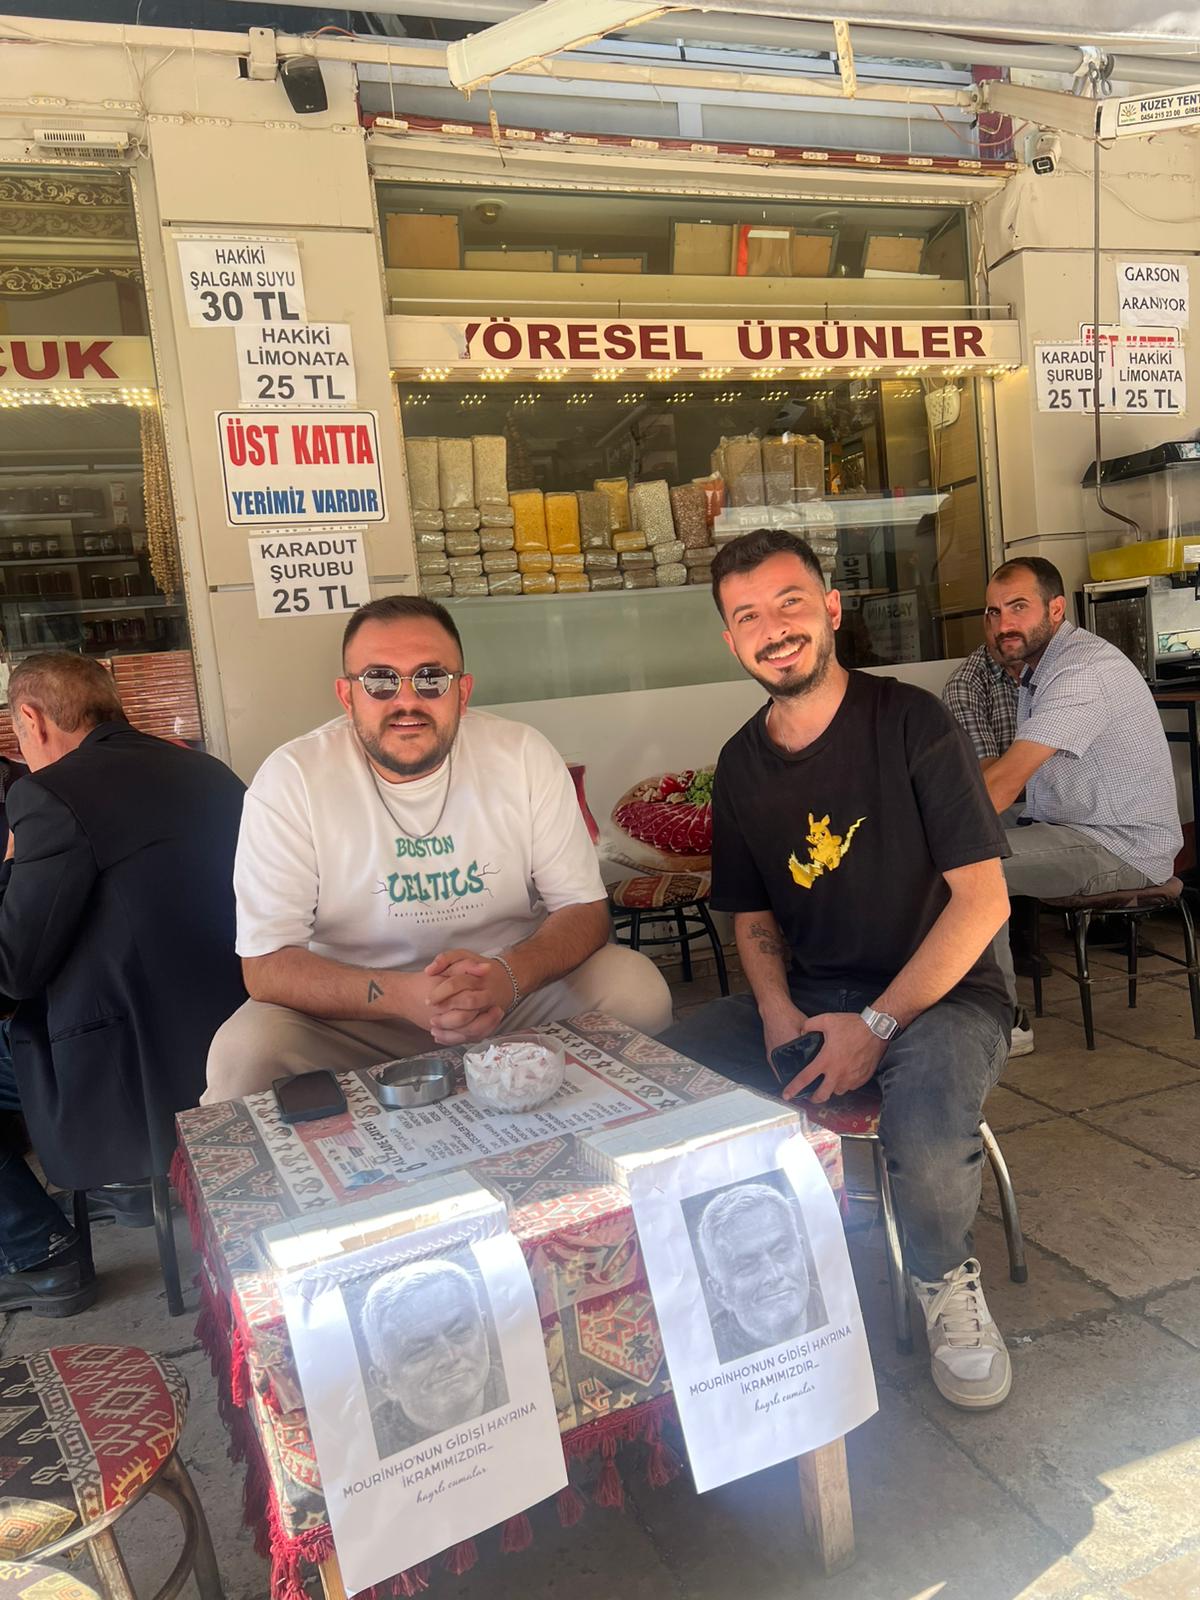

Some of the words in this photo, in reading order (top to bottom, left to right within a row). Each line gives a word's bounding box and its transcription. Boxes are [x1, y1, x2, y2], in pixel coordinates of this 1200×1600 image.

[1140, 98, 1174, 112] KUZEY
[216, 245, 265, 264] HAKİKİ
[190, 271, 253, 290] ŞALGAM
[256, 272, 295, 286] SUYU
[1125, 266, 1180, 282] GARSON
[200, 291, 244, 321] 30
[254, 292, 300, 320] TL
[1122, 297, 1186, 311] ARANIYOR
[262, 326, 330, 344] HAKİKİ
[738, 320, 986, 360] ÜRÜNLER
[247, 346, 349, 366] LİMONATA
[1130, 350, 1172, 365] HAKİKİ
[1120, 366, 1183, 382] LİMONATA
[257, 374, 294, 399] 25
[304, 375, 345, 399] TL
[1048, 389, 1072, 408] 25
[1126, 389, 1148, 408] 25
[1154, 389, 1178, 408] TL
[226, 418, 279, 466] ÜST
[292, 425, 374, 464] KATTA
[232, 486, 306, 515] YERİMİZ
[312, 489, 379, 514] VARDIR
[261, 539, 357, 559] KARADUT
[270, 560, 354, 583] ŞURUBU
[273, 588, 310, 614] 25
[319, 585, 360, 610] TL
[395, 834, 455, 858] BOSTON
[387, 860, 484, 902] CELTICS
[689, 1357, 775, 1396] MOURİNHO'NUN
[777, 1343, 811, 1364] GİDİŞİ
[813, 1326, 852, 1351] HAYRINA
[342, 1444, 442, 1498] MOURİNHO'NUN
[446, 1424, 485, 1450] GİDİŞİ
[487, 1402, 537, 1433] HAYRINA
